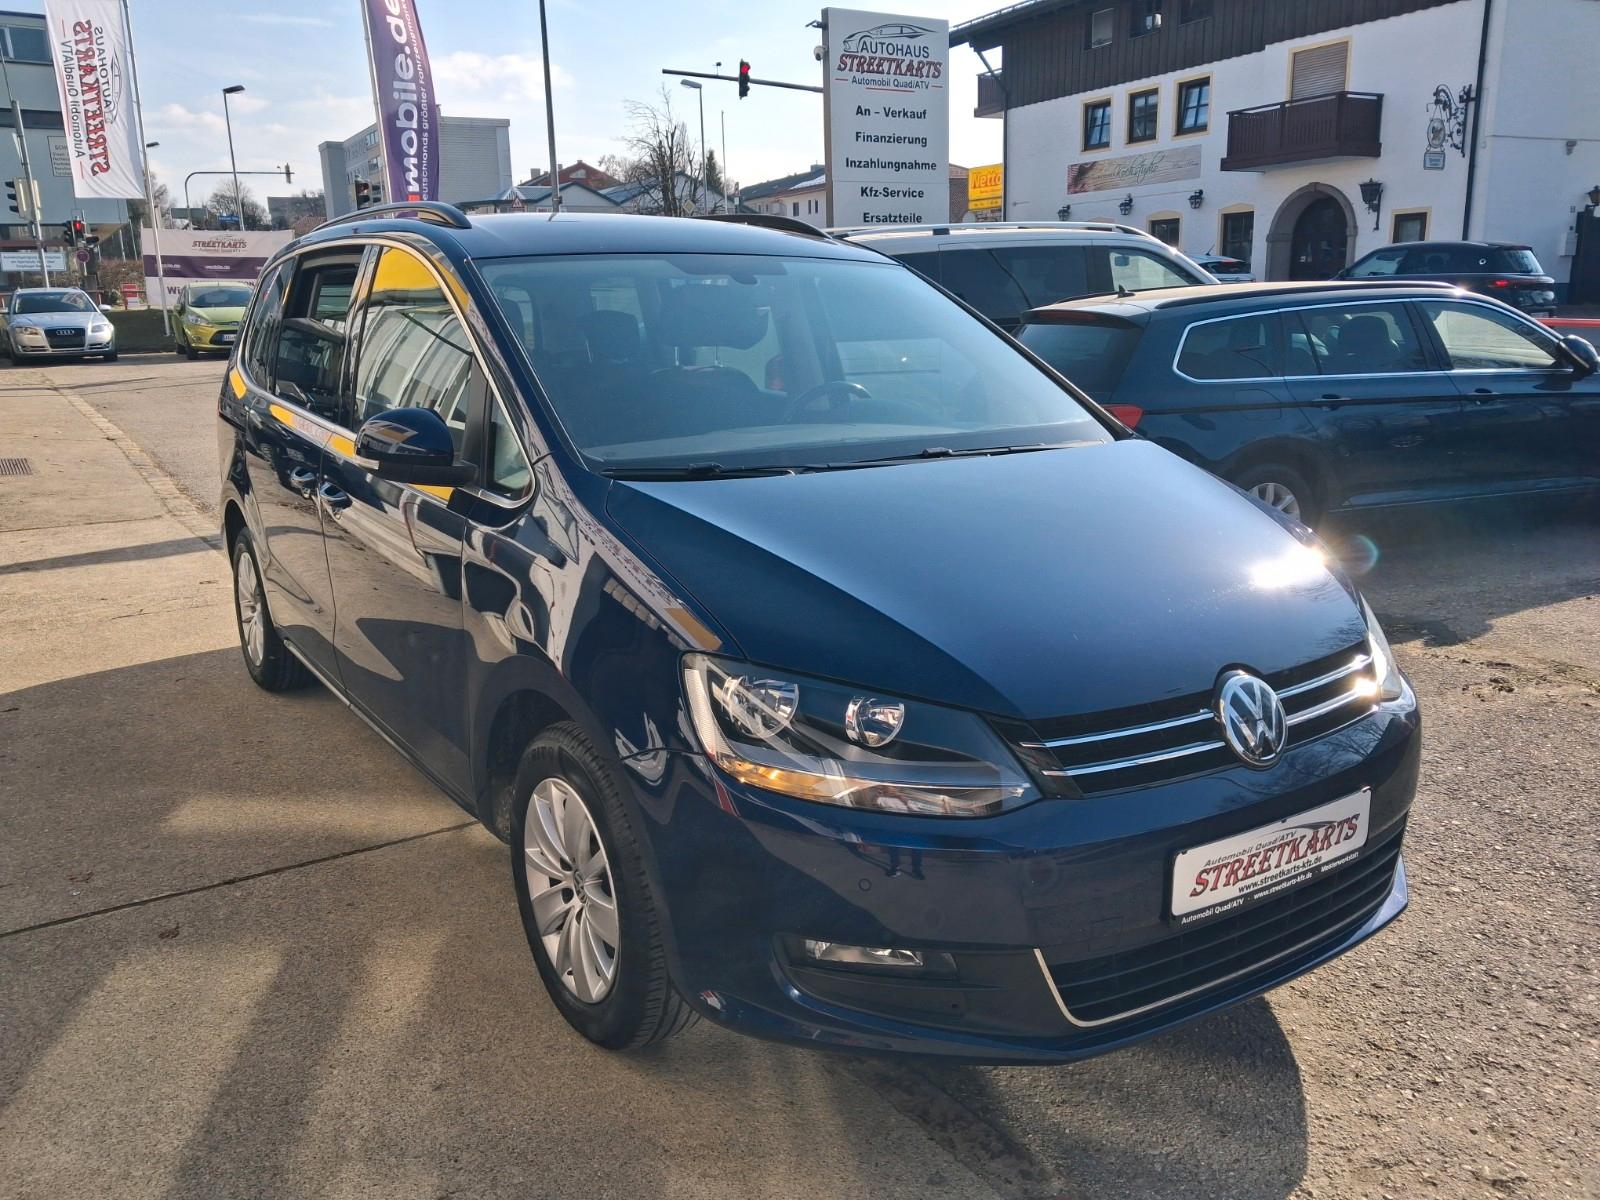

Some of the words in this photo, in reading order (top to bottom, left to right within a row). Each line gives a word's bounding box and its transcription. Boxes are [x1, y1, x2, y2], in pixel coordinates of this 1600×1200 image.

[860, 40, 930, 59] AUTOHAUS
[837, 53, 943, 79] STREETKARTS
[851, 75, 891, 87] Automobil
[893, 78, 930, 90] Quad/ATV
[384, 0, 421, 192] mobile.de
[855, 105, 871, 117] An
[883, 106, 927, 120] Verkauf
[855, 131, 928, 147] Finanzierung
[422, 132, 430, 200] eutschlands
[845, 157, 937, 172] Inzahlungnahme
[860, 186, 925, 199] Kfz-Service
[863, 212, 923, 224] Ersatzteile
[192, 240, 248, 249] STREETKARTS
[1189, 813, 1361, 898] STREETKARTS
[1204, 845, 1254, 868] Automobil
[1255, 829, 1298, 852] Quad/ATV
[1237, 855, 1323, 894] www.streetkarts-kfz.de
[1181, 907, 1214, 925] Automobil
